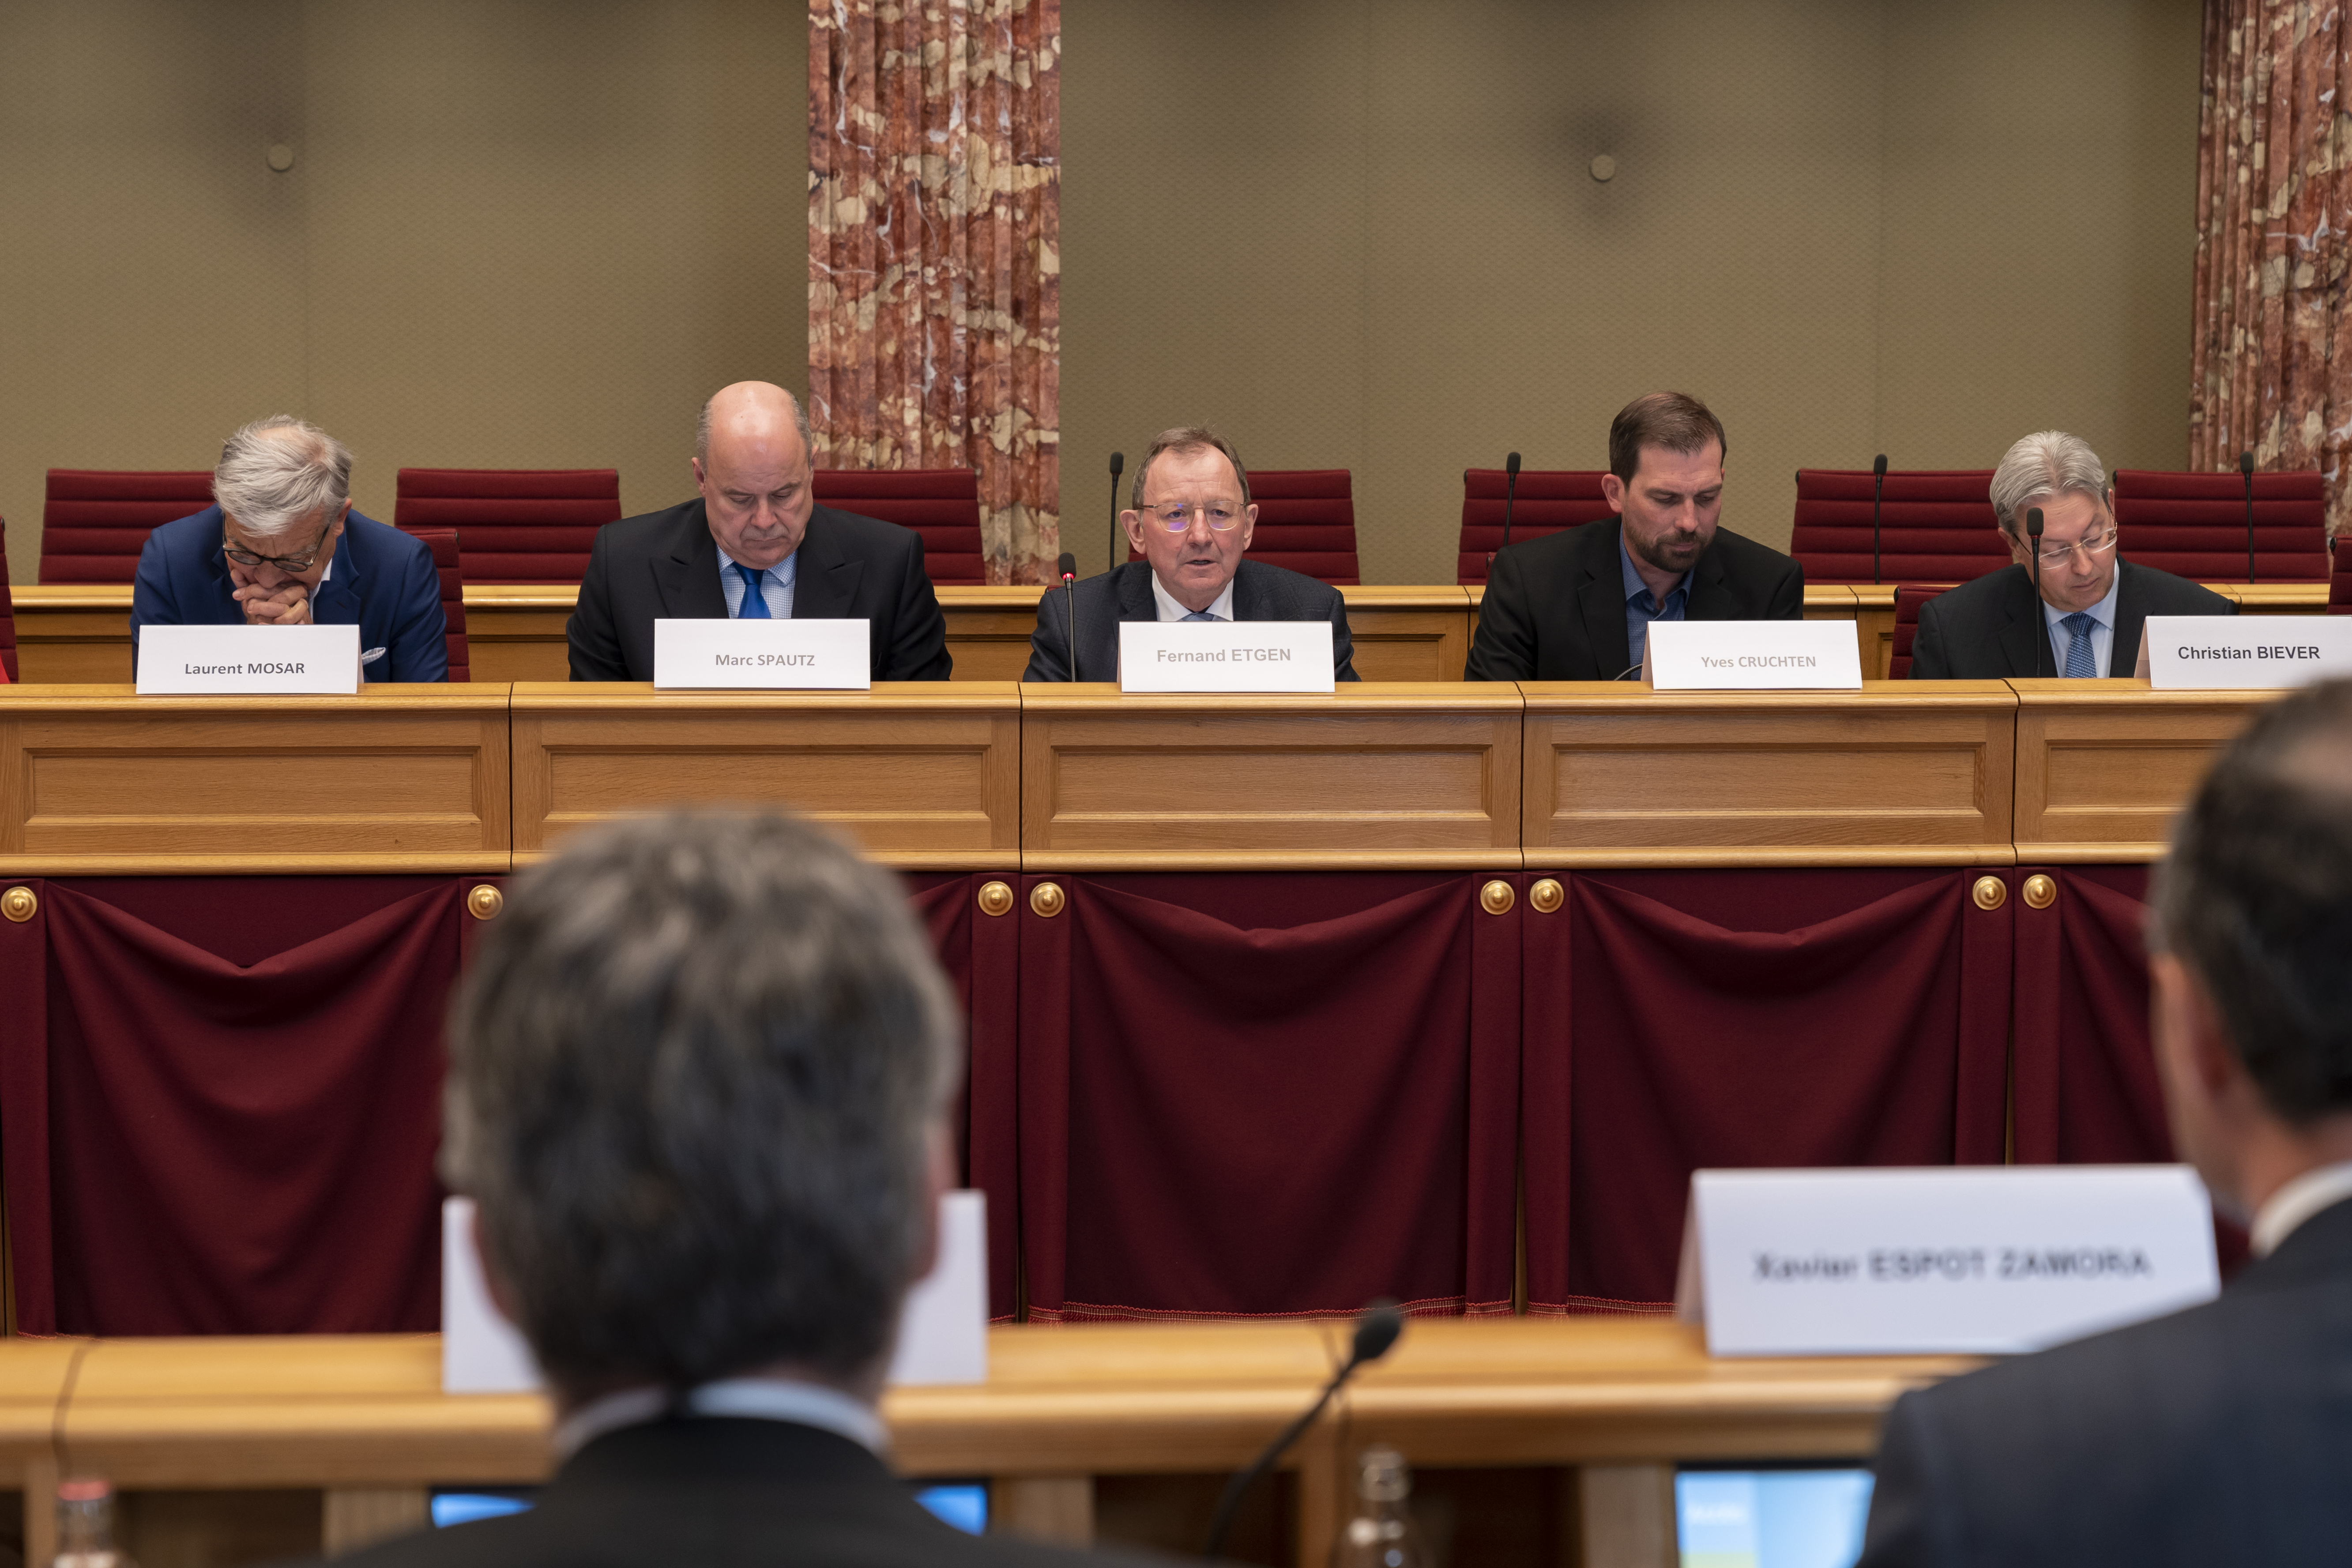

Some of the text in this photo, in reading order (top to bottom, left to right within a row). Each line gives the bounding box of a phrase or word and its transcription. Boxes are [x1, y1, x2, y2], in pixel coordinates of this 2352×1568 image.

[1157, 648, 1291, 662] Fernand ETGEN
[2178, 646, 2321, 659] Christian BIEVER
[715, 654, 815, 666] Marc SPAUTZ
[1700, 656, 1816, 668] Yves CRUCHTEN
[184, 662, 305, 674] Laurent MOSAR
[1753, 1247, 2152, 1281] Xavier ESPOT ZAMORA
